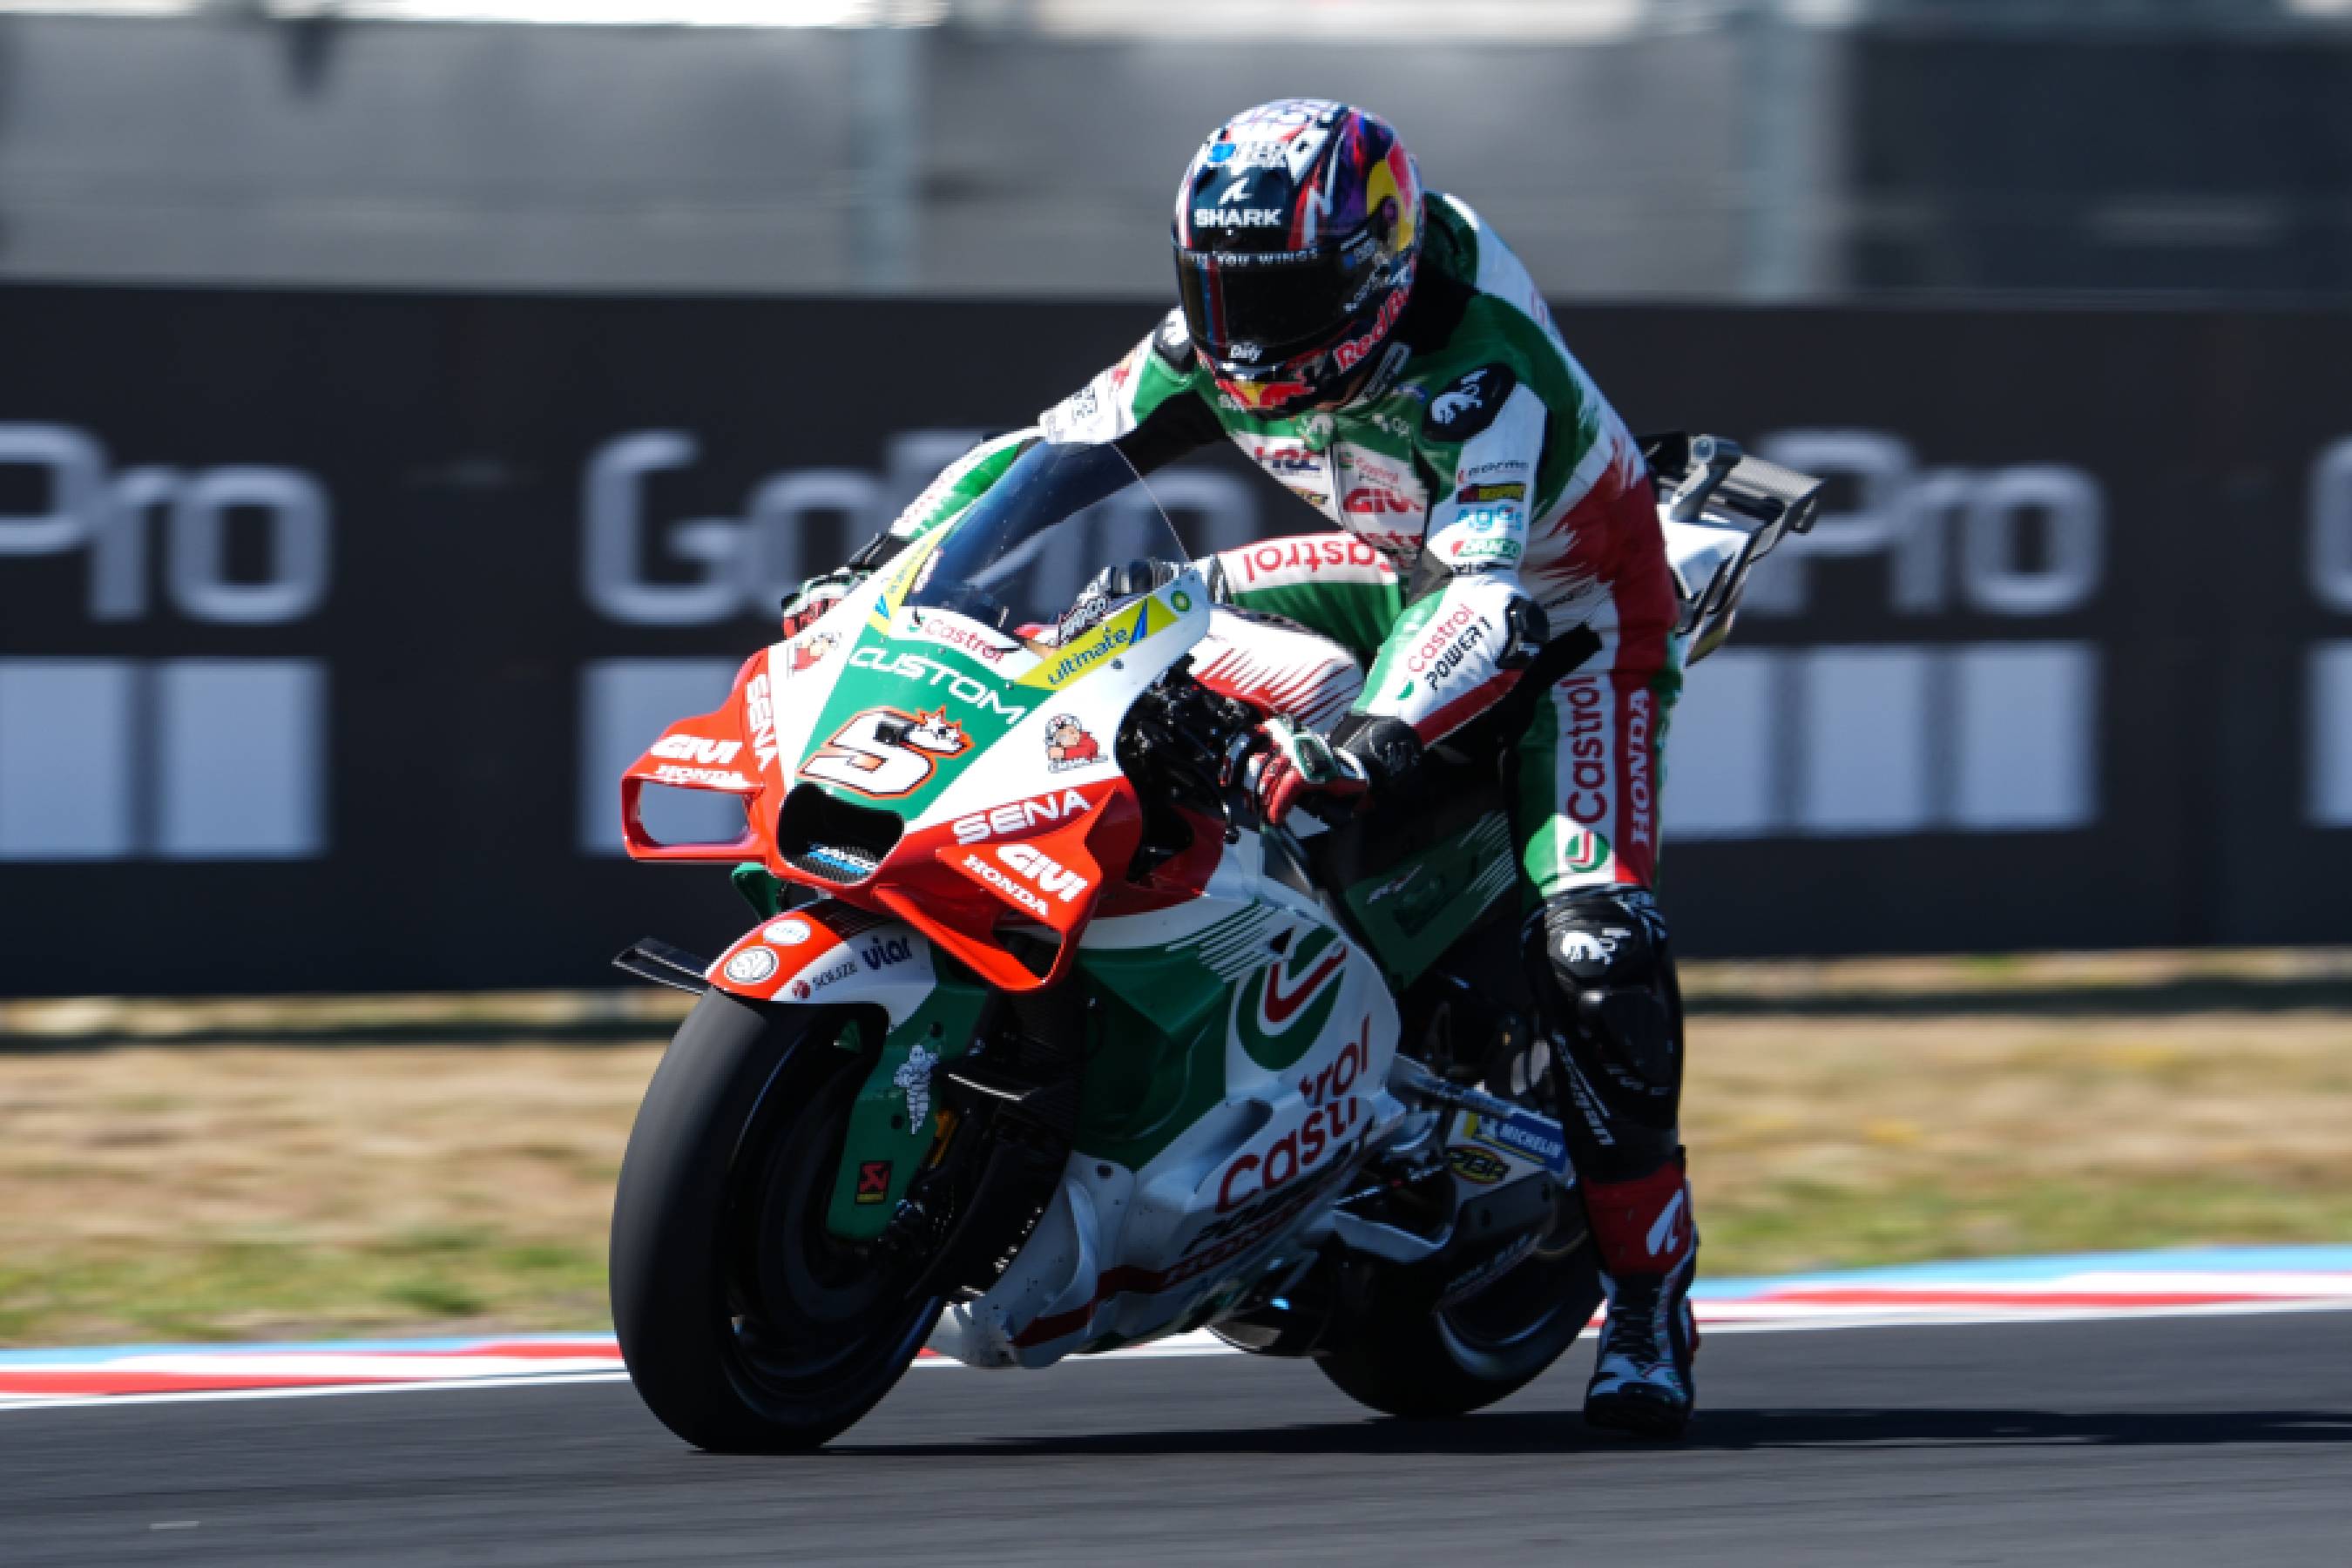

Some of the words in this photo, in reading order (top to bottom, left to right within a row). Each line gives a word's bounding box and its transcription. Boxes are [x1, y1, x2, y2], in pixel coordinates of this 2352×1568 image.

[1194, 208, 1282, 227] SHARK
[0, 421, 336, 624] Pro
[925, 618, 1004, 663] Castrol
[1048, 626, 1128, 685] ultimate
[1407, 603, 1475, 672] Castrol
[849, 647, 1027, 725] CUSTOM
[651, 733, 743, 764] GIVI
[747, 673, 778, 773] SENA
[796, 706, 974, 798] 5
[1560, 676, 1607, 824] Castrol
[1629, 687, 1651, 844] HONDA
[953, 789, 1092, 845] SENA
[963, 855, 1048, 916] HONDA
[997, 845, 1088, 902] GIVI
[1215, 1013, 1370, 1213] Castrol
